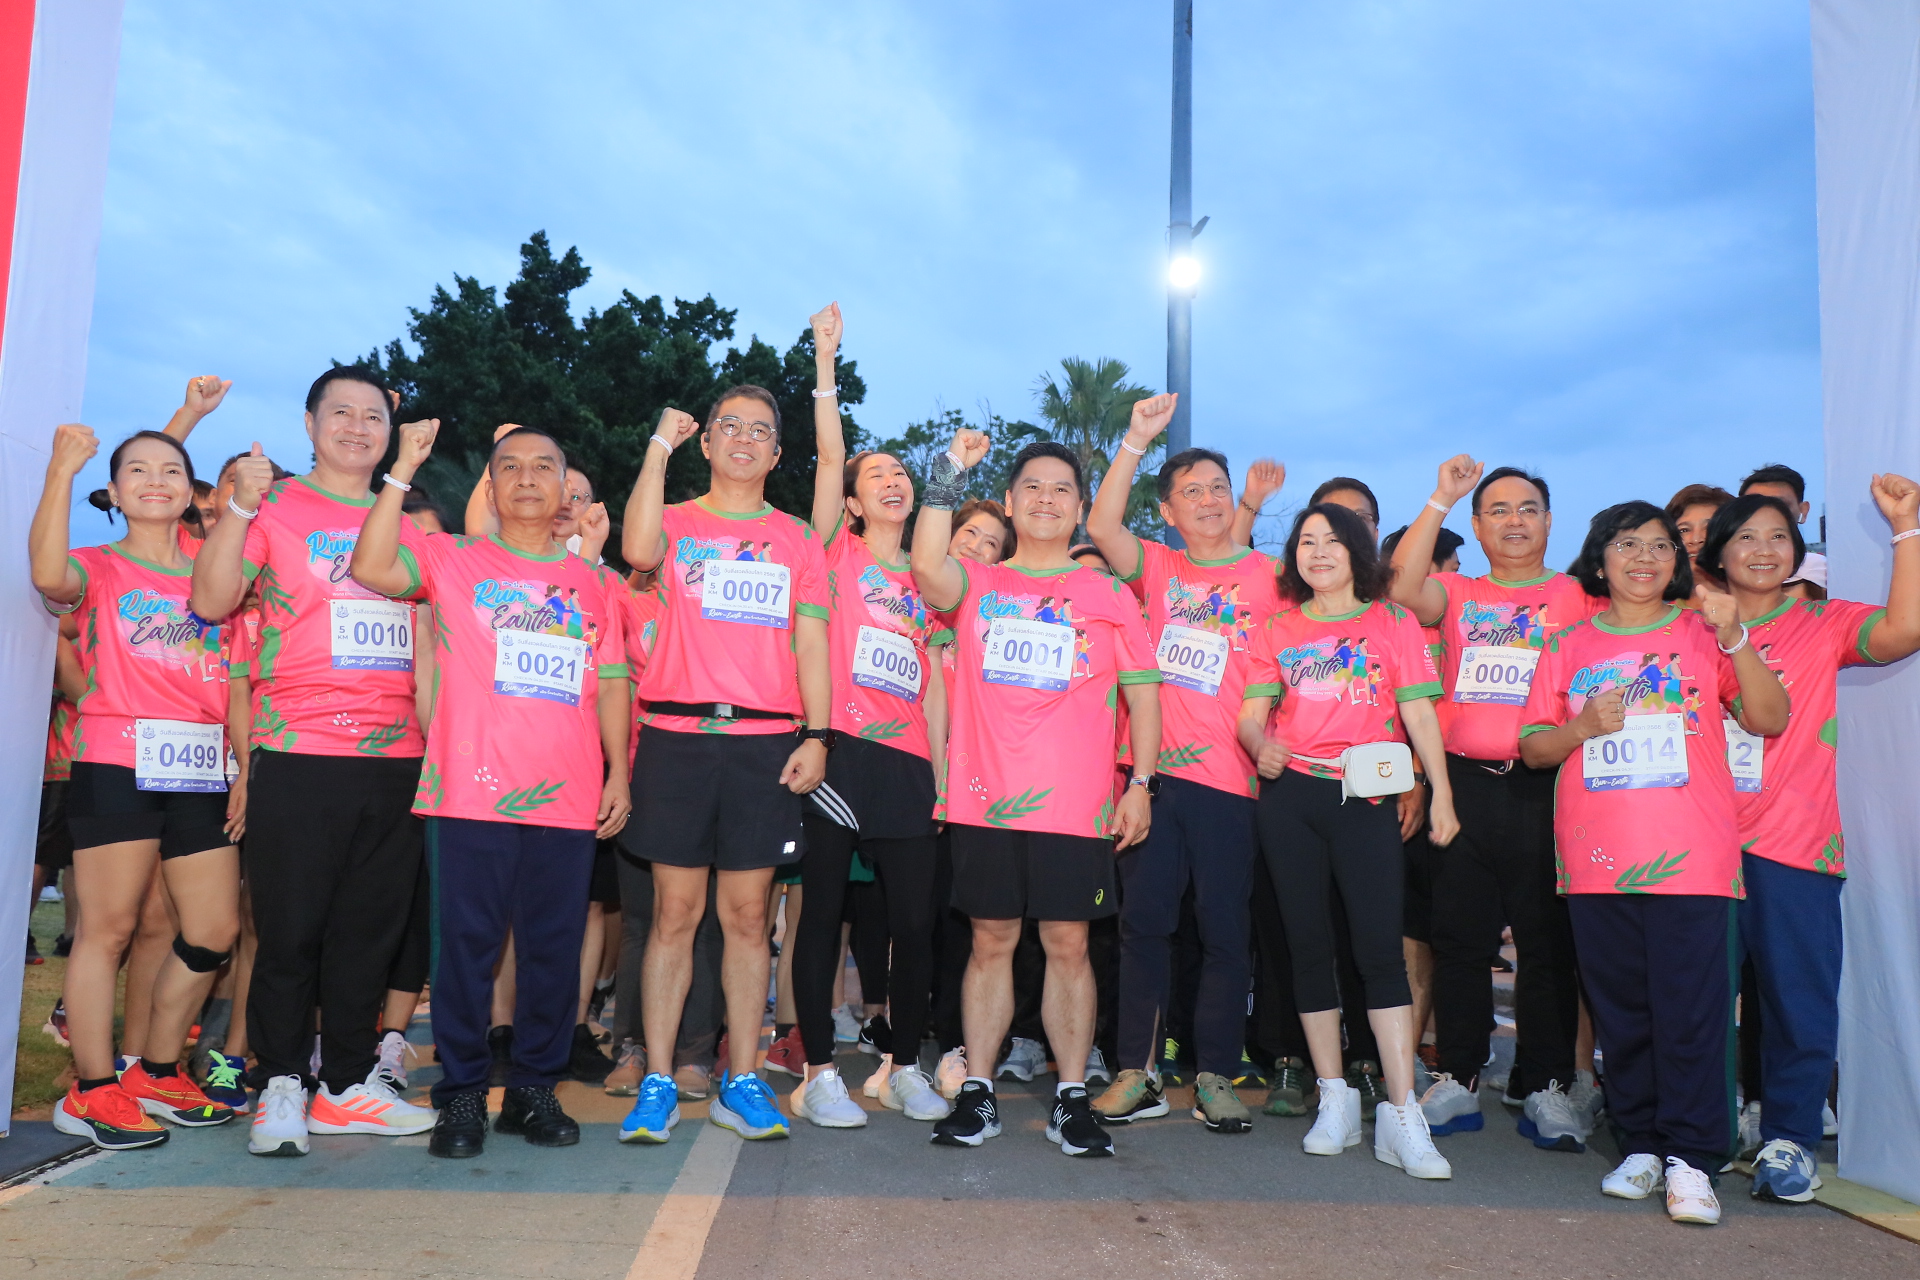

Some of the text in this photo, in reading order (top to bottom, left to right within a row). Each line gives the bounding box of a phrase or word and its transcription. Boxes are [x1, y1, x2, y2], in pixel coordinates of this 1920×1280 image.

[306, 530, 356, 564] Run
[675, 535, 723, 566] Run
[118, 588, 174, 622] Run
[473, 578, 530, 609] Run
[723, 580, 783, 605] 0007
[978, 589, 1023, 621] Run
[490, 603, 558, 633] Earth
[1459, 599, 1500, 625] Run
[128, 615, 199, 647] Earth
[354, 621, 408, 648] 0010
[1467, 622, 1520, 646] Earth
[517, 651, 576, 682] 0021
[872, 648, 918, 681] 0009
[1004, 639, 1063, 668] 0001
[1167, 644, 1220, 675] 0002
[1276, 647, 1322, 668] Run
[1290, 657, 1344, 687] Earth
[1475, 664, 1534, 687] 0004
[1568, 666, 1622, 701] Run
[1615, 676, 1633, 685] for
[159, 743, 217, 769] 0499
[1602, 737, 1677, 765] 0014
[1726, 742, 1752, 766] 2
